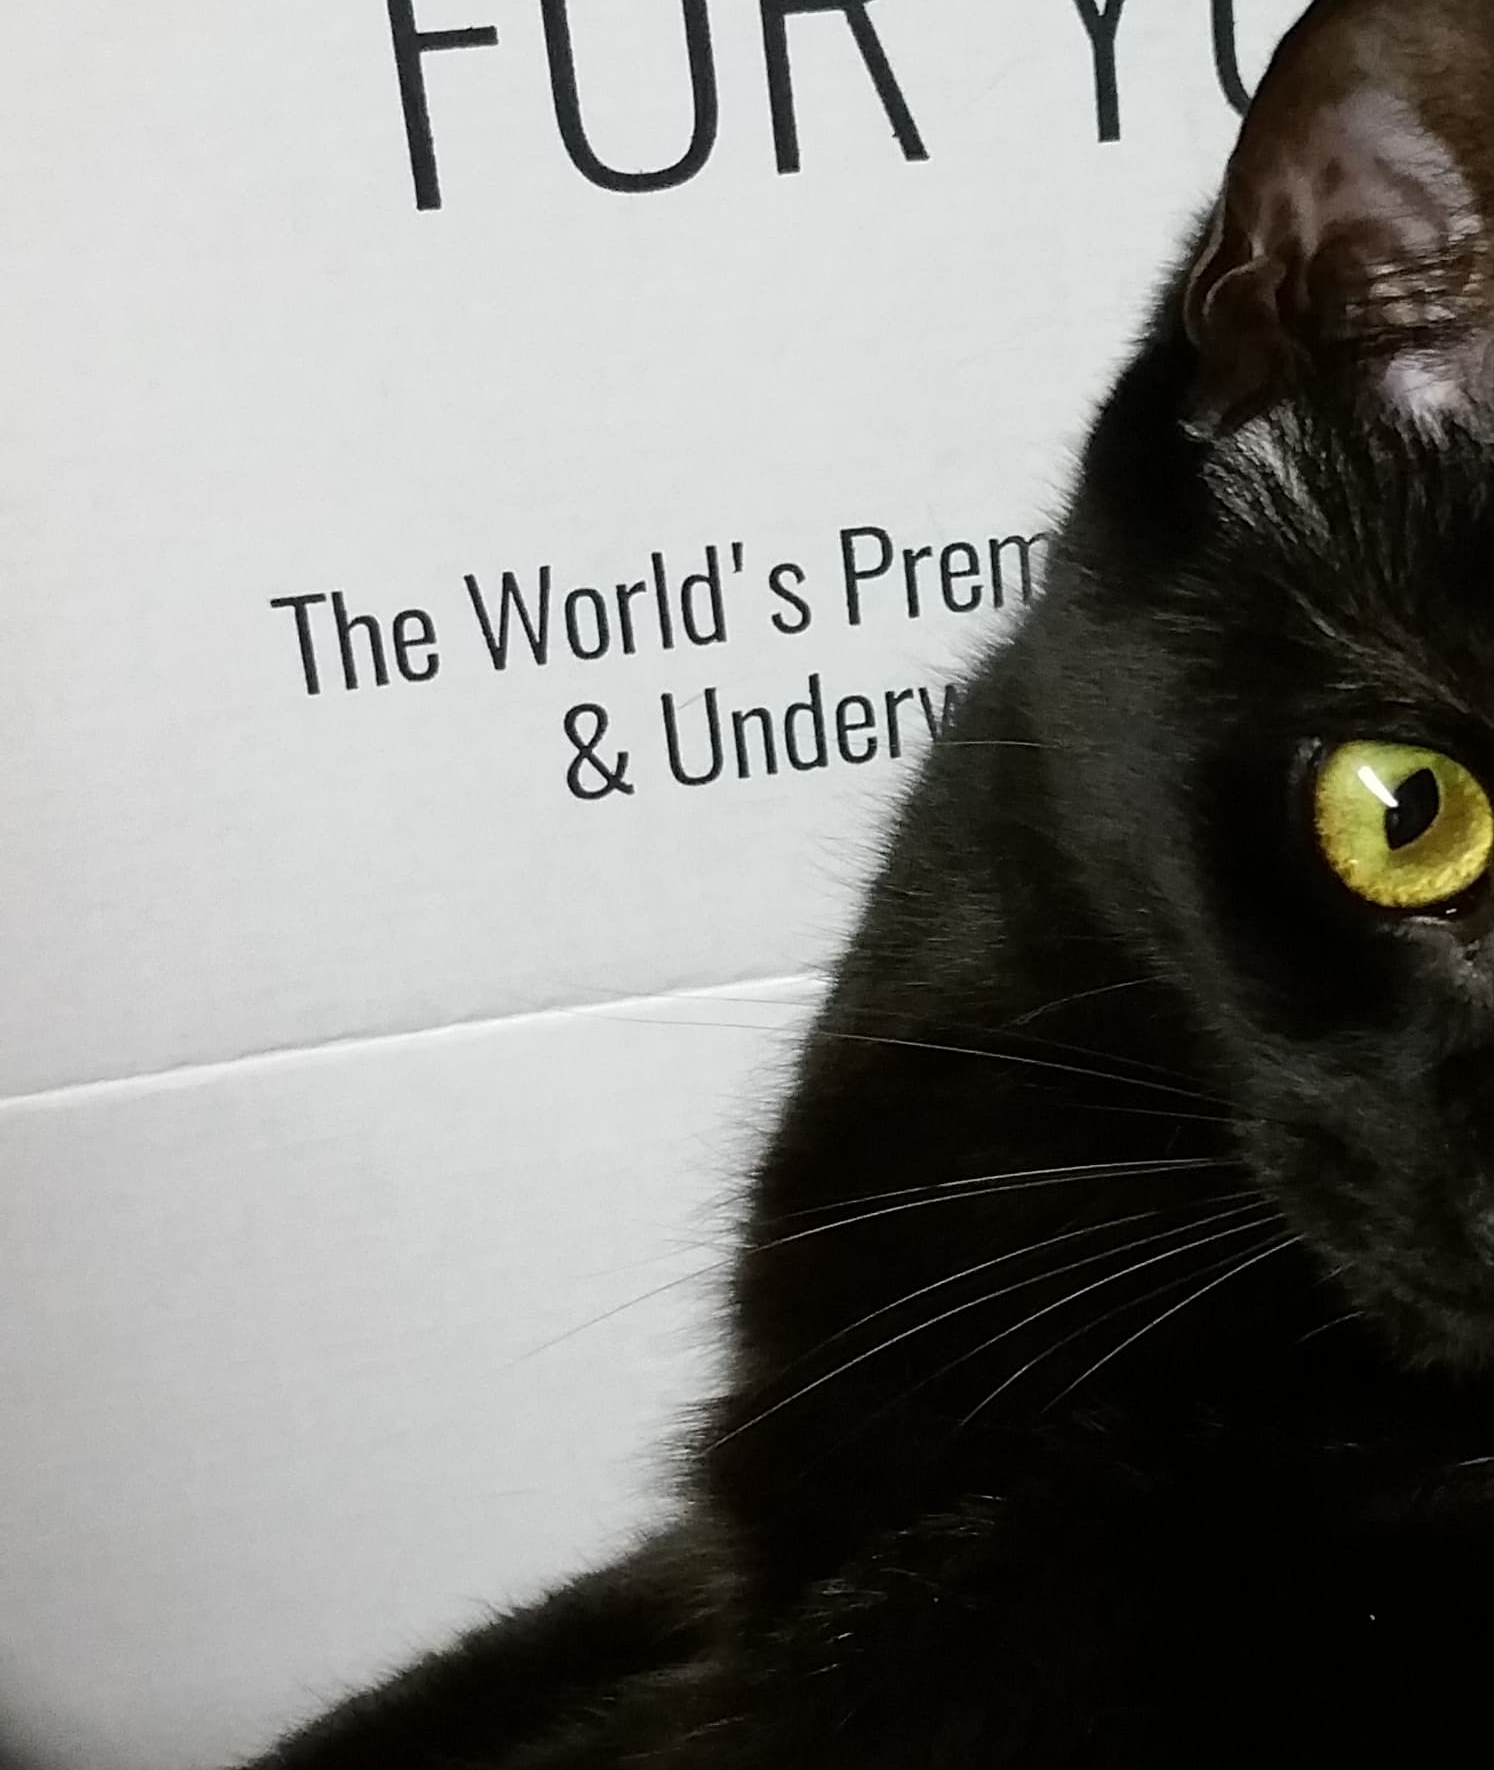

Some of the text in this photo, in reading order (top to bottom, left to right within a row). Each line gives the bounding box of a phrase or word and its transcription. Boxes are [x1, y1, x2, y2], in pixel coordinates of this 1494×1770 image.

[270, 589, 439, 695] The
[463, 541, 811, 671] World's
[563, 703, 634, 800] &
